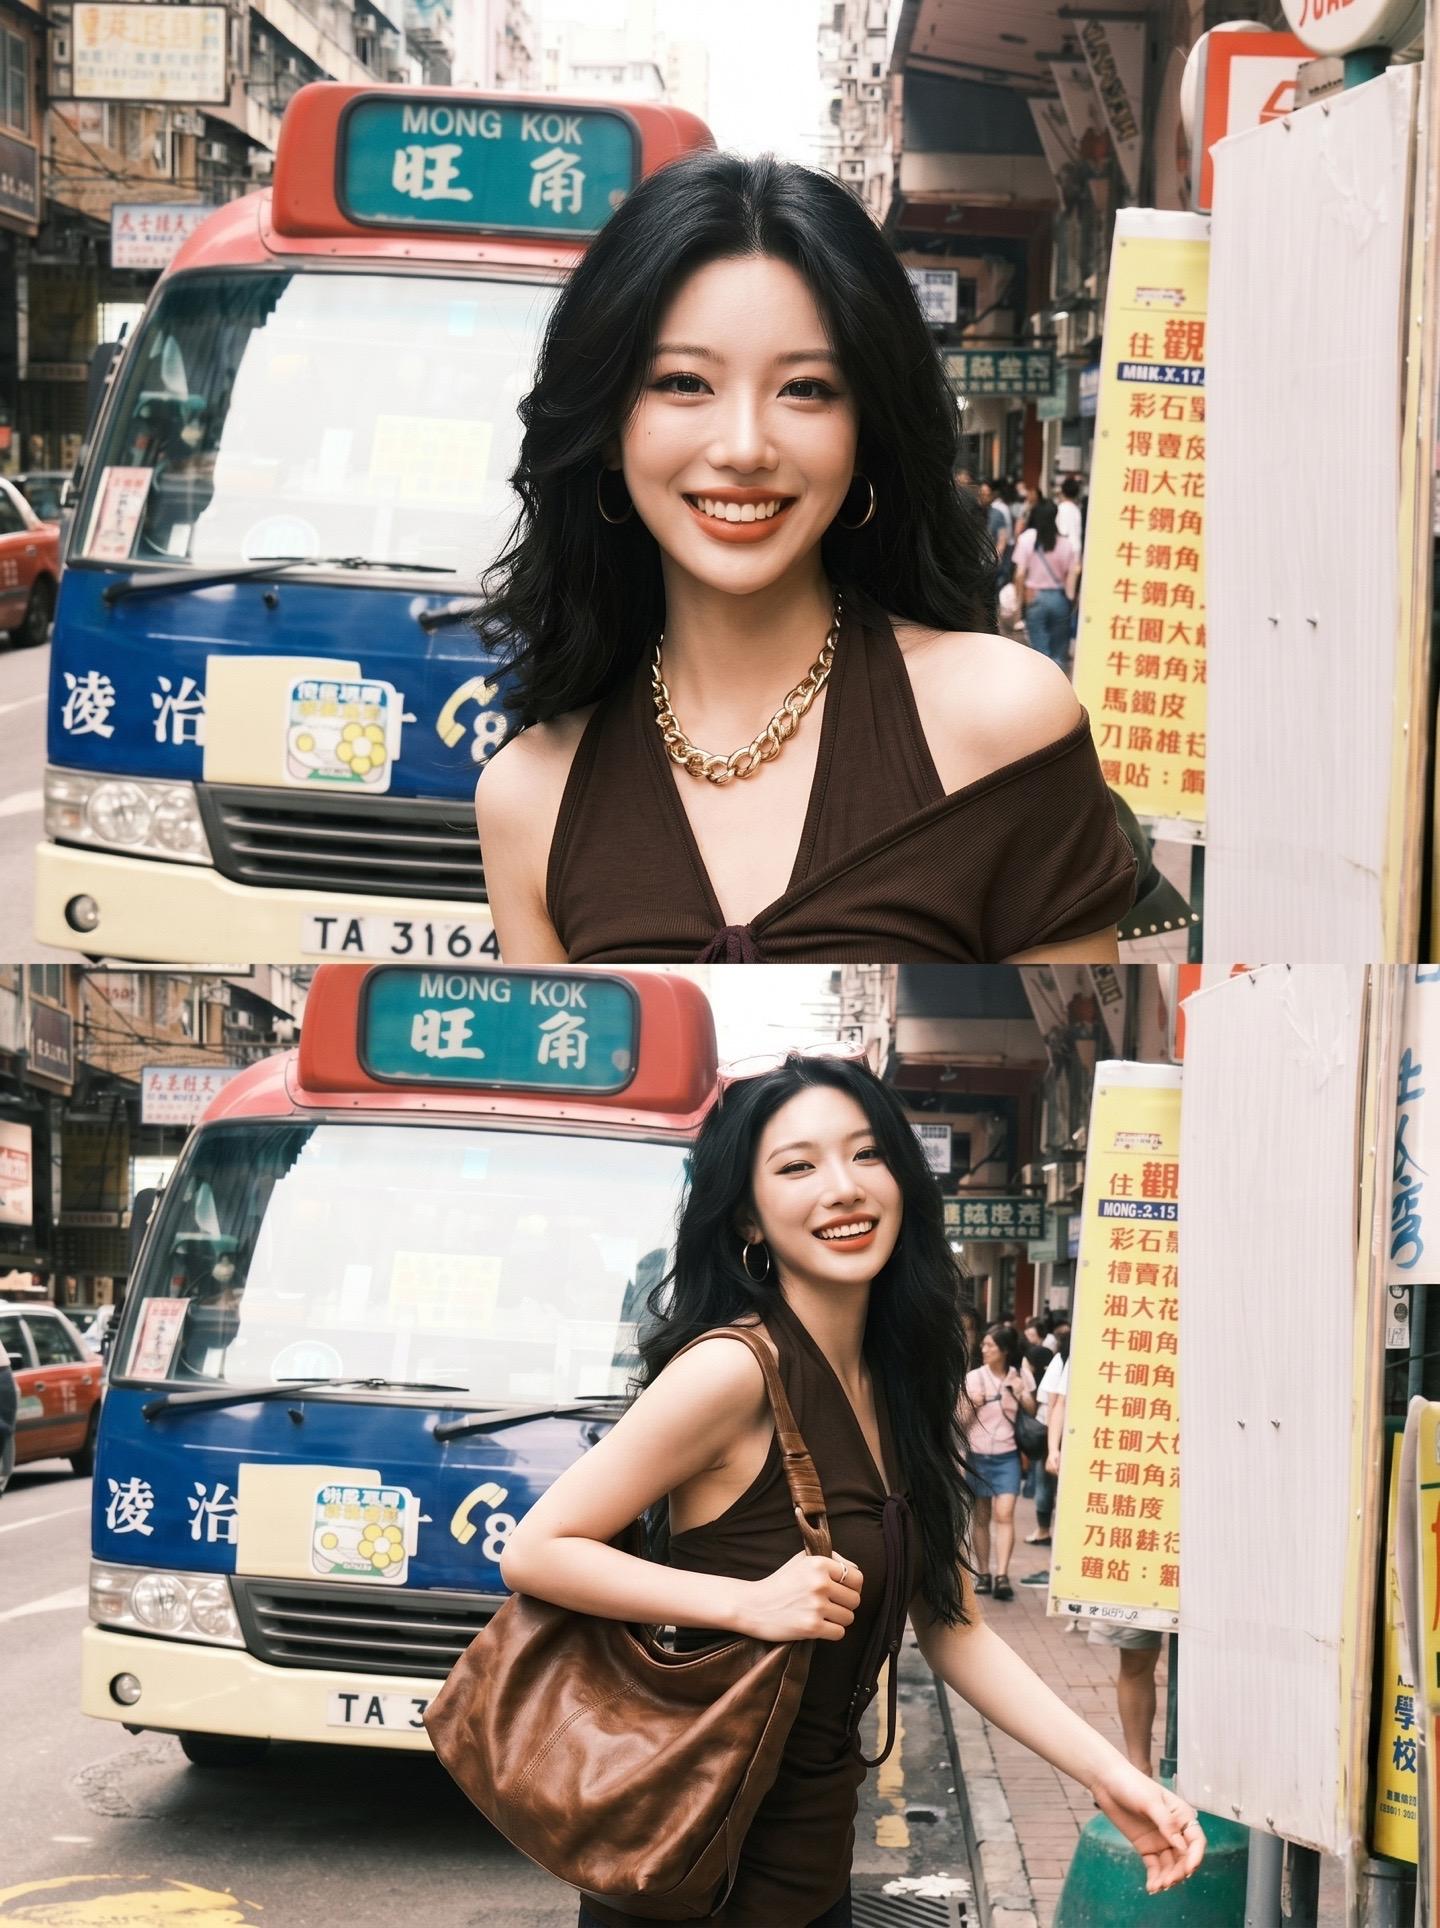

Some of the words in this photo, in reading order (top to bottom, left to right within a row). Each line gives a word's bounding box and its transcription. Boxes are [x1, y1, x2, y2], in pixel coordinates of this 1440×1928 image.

[402, 106, 501, 138] MONG
[521, 114, 583, 145] KOK
[392, 143, 586, 213] 旺角
[314, 917, 364, 952] TA
[391, 922, 500, 960] 3164
[419, 974, 511, 1002] MONG
[530, 980, 587, 1008] KOK
[410, 1007, 589, 1069] 旺角
[482, 1512, 517, 1563] 8
[338, 1693, 385, 1725] TA
